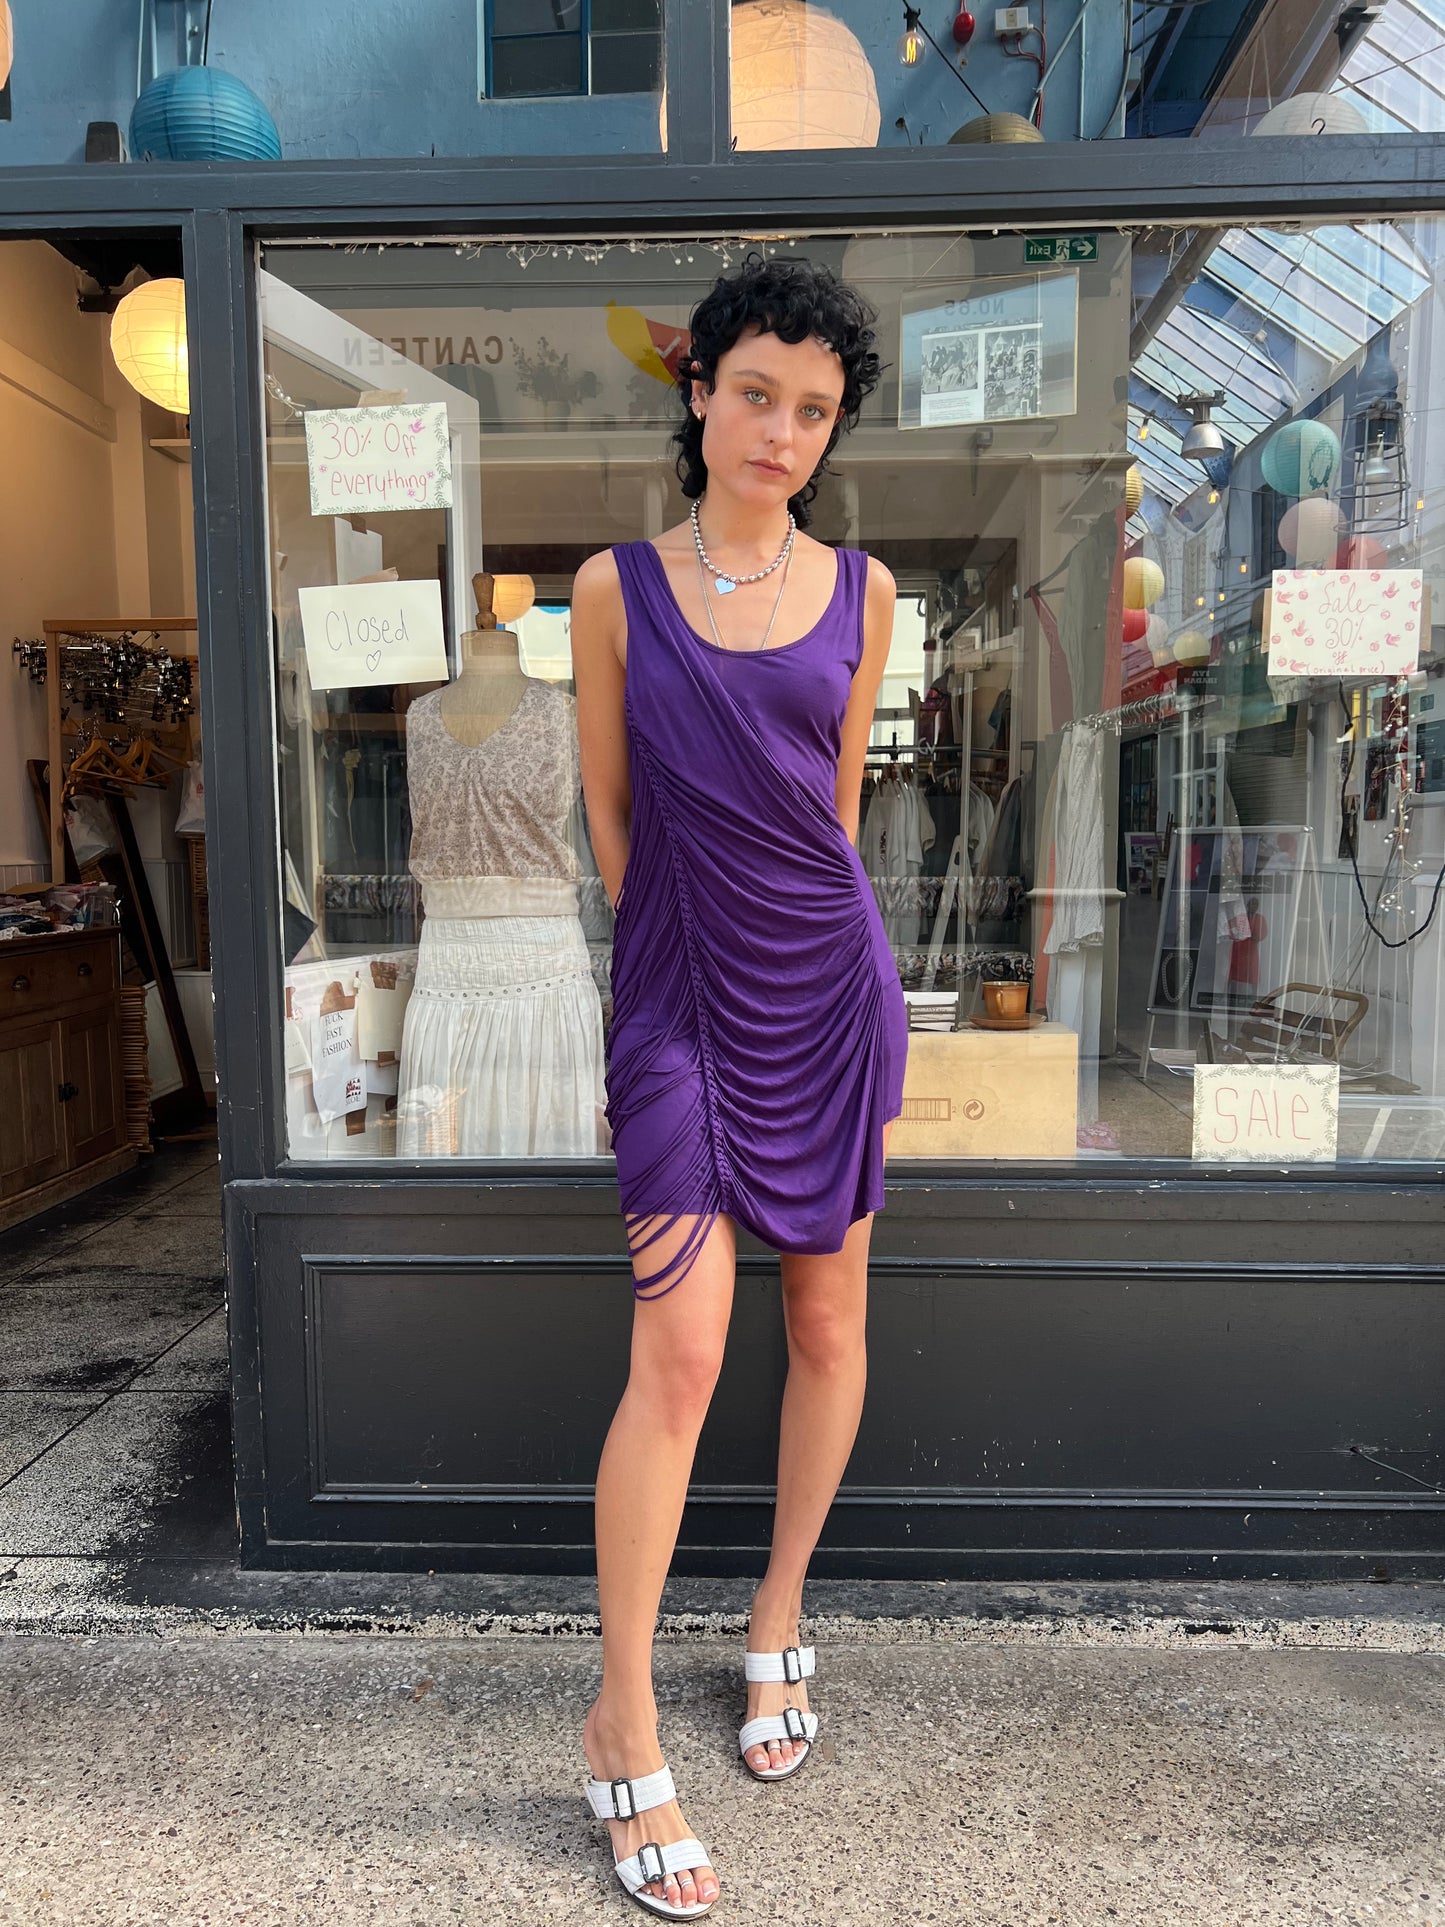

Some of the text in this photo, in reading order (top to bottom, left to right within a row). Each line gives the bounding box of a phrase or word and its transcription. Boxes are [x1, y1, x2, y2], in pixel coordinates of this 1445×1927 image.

[321, 422, 417, 460] 30% Off
[330, 468, 428, 503] everything
[1318, 580, 1380, 615] Sale
[325, 608, 410, 652] Closed
[1324, 616, 1365, 650] 30%
[1332, 650, 1348, 666] off
[324, 1011, 344, 1026] FUCK
[326, 1026, 343, 1041] FAST
[321, 1037, 353, 1059] FASHION
